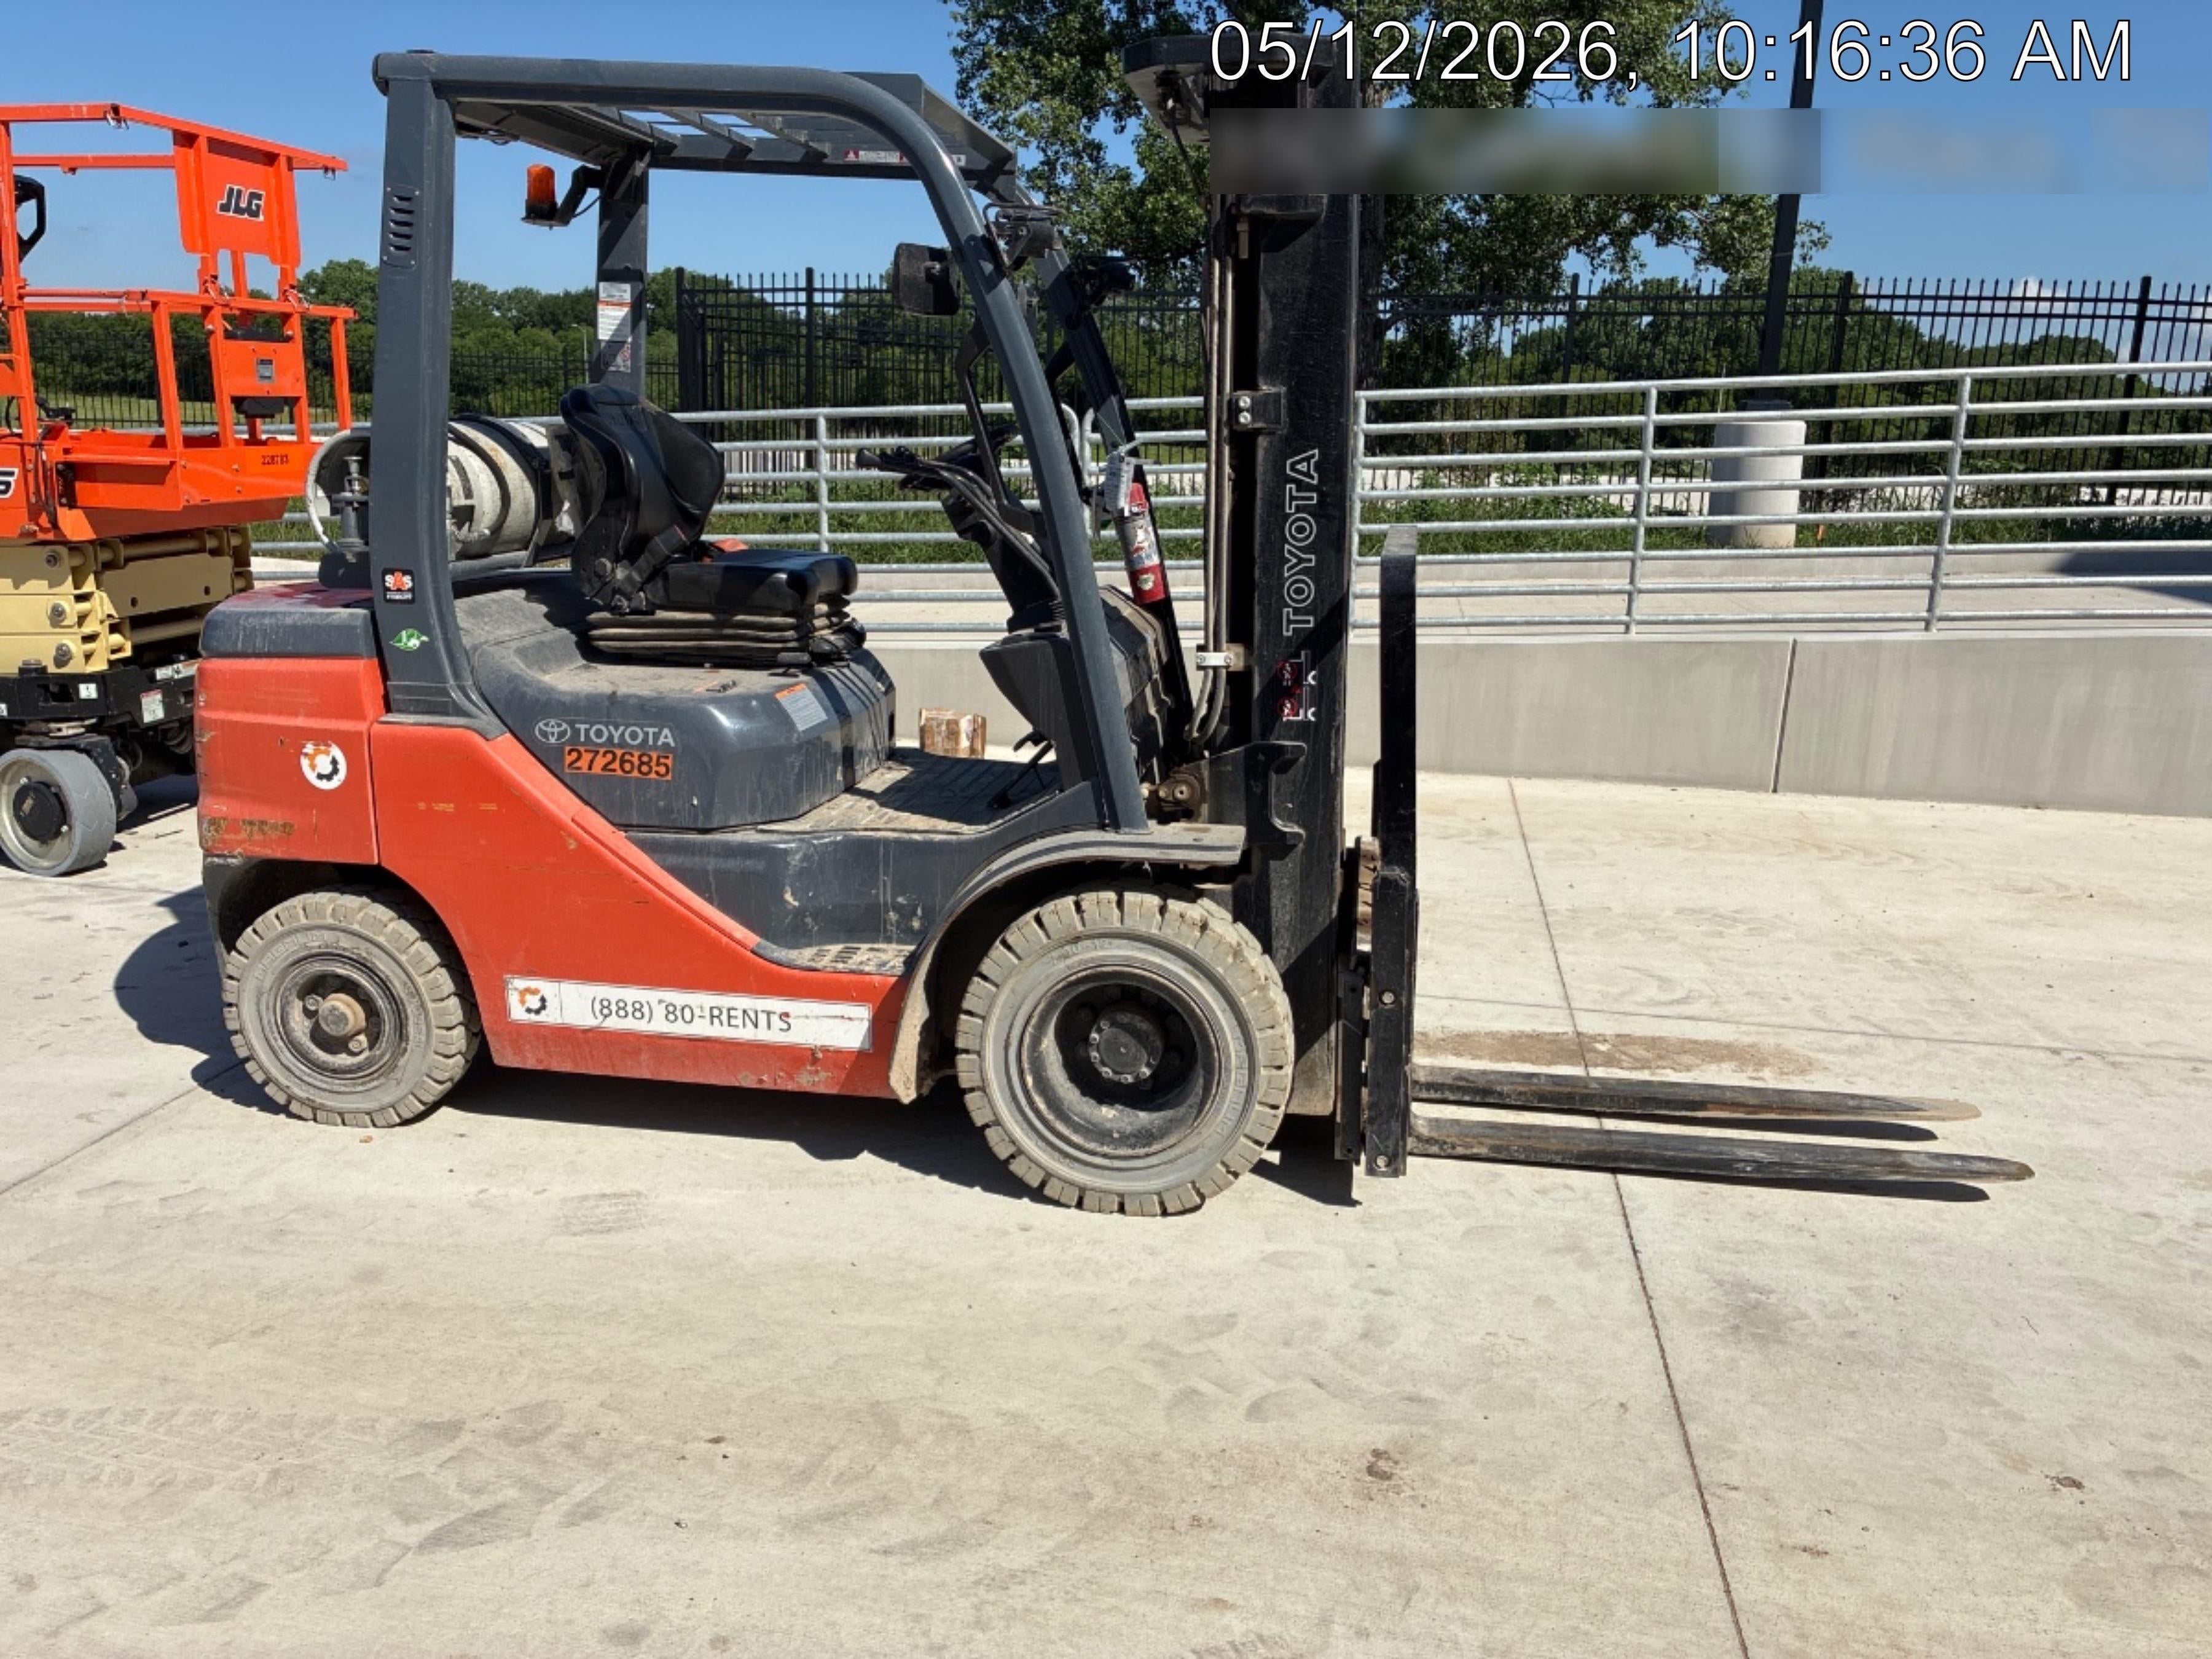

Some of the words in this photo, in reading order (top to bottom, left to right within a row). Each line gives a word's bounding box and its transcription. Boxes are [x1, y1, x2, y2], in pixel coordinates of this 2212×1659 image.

[218, 185, 265, 220] JLG
[1282, 448, 1319, 637] TOYOTA
[385, 571, 413, 590] SAS
[575, 723, 676, 747] TOYOTA
[567, 748, 670, 778] 272685
[591, 996, 653, 1024] (888)
[664, 1002, 792, 1032] 80-RENTS
